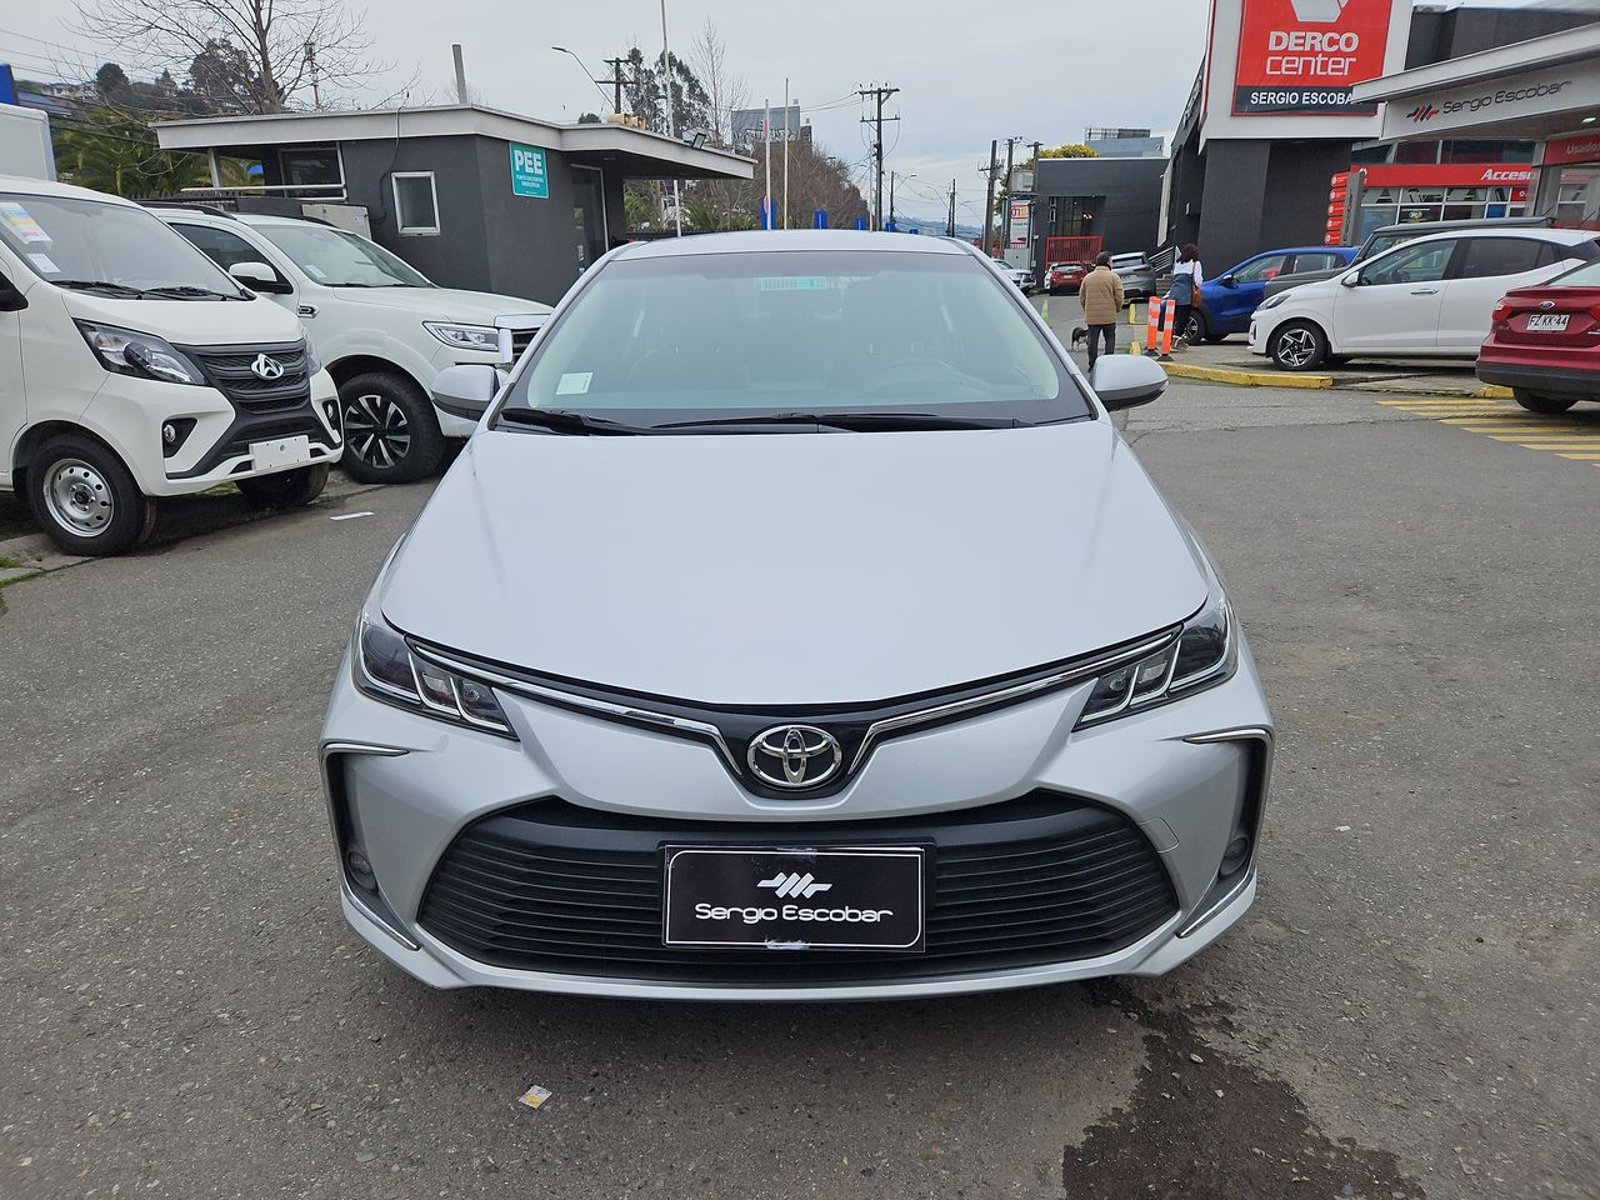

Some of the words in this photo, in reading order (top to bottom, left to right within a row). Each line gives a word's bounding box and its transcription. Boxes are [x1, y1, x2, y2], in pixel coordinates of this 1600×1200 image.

[1268, 31, 1360, 52] DERCO
[1265, 53, 1357, 75] center
[1250, 91, 1300, 105] SERGIO
[1301, 91, 1356, 105] ESCOBA
[1494, 80, 1573, 104] Escobar
[514, 149, 544, 175] PEE
[694, 903, 778, 924] Sergio
[782, 904, 894, 923] Escobar
